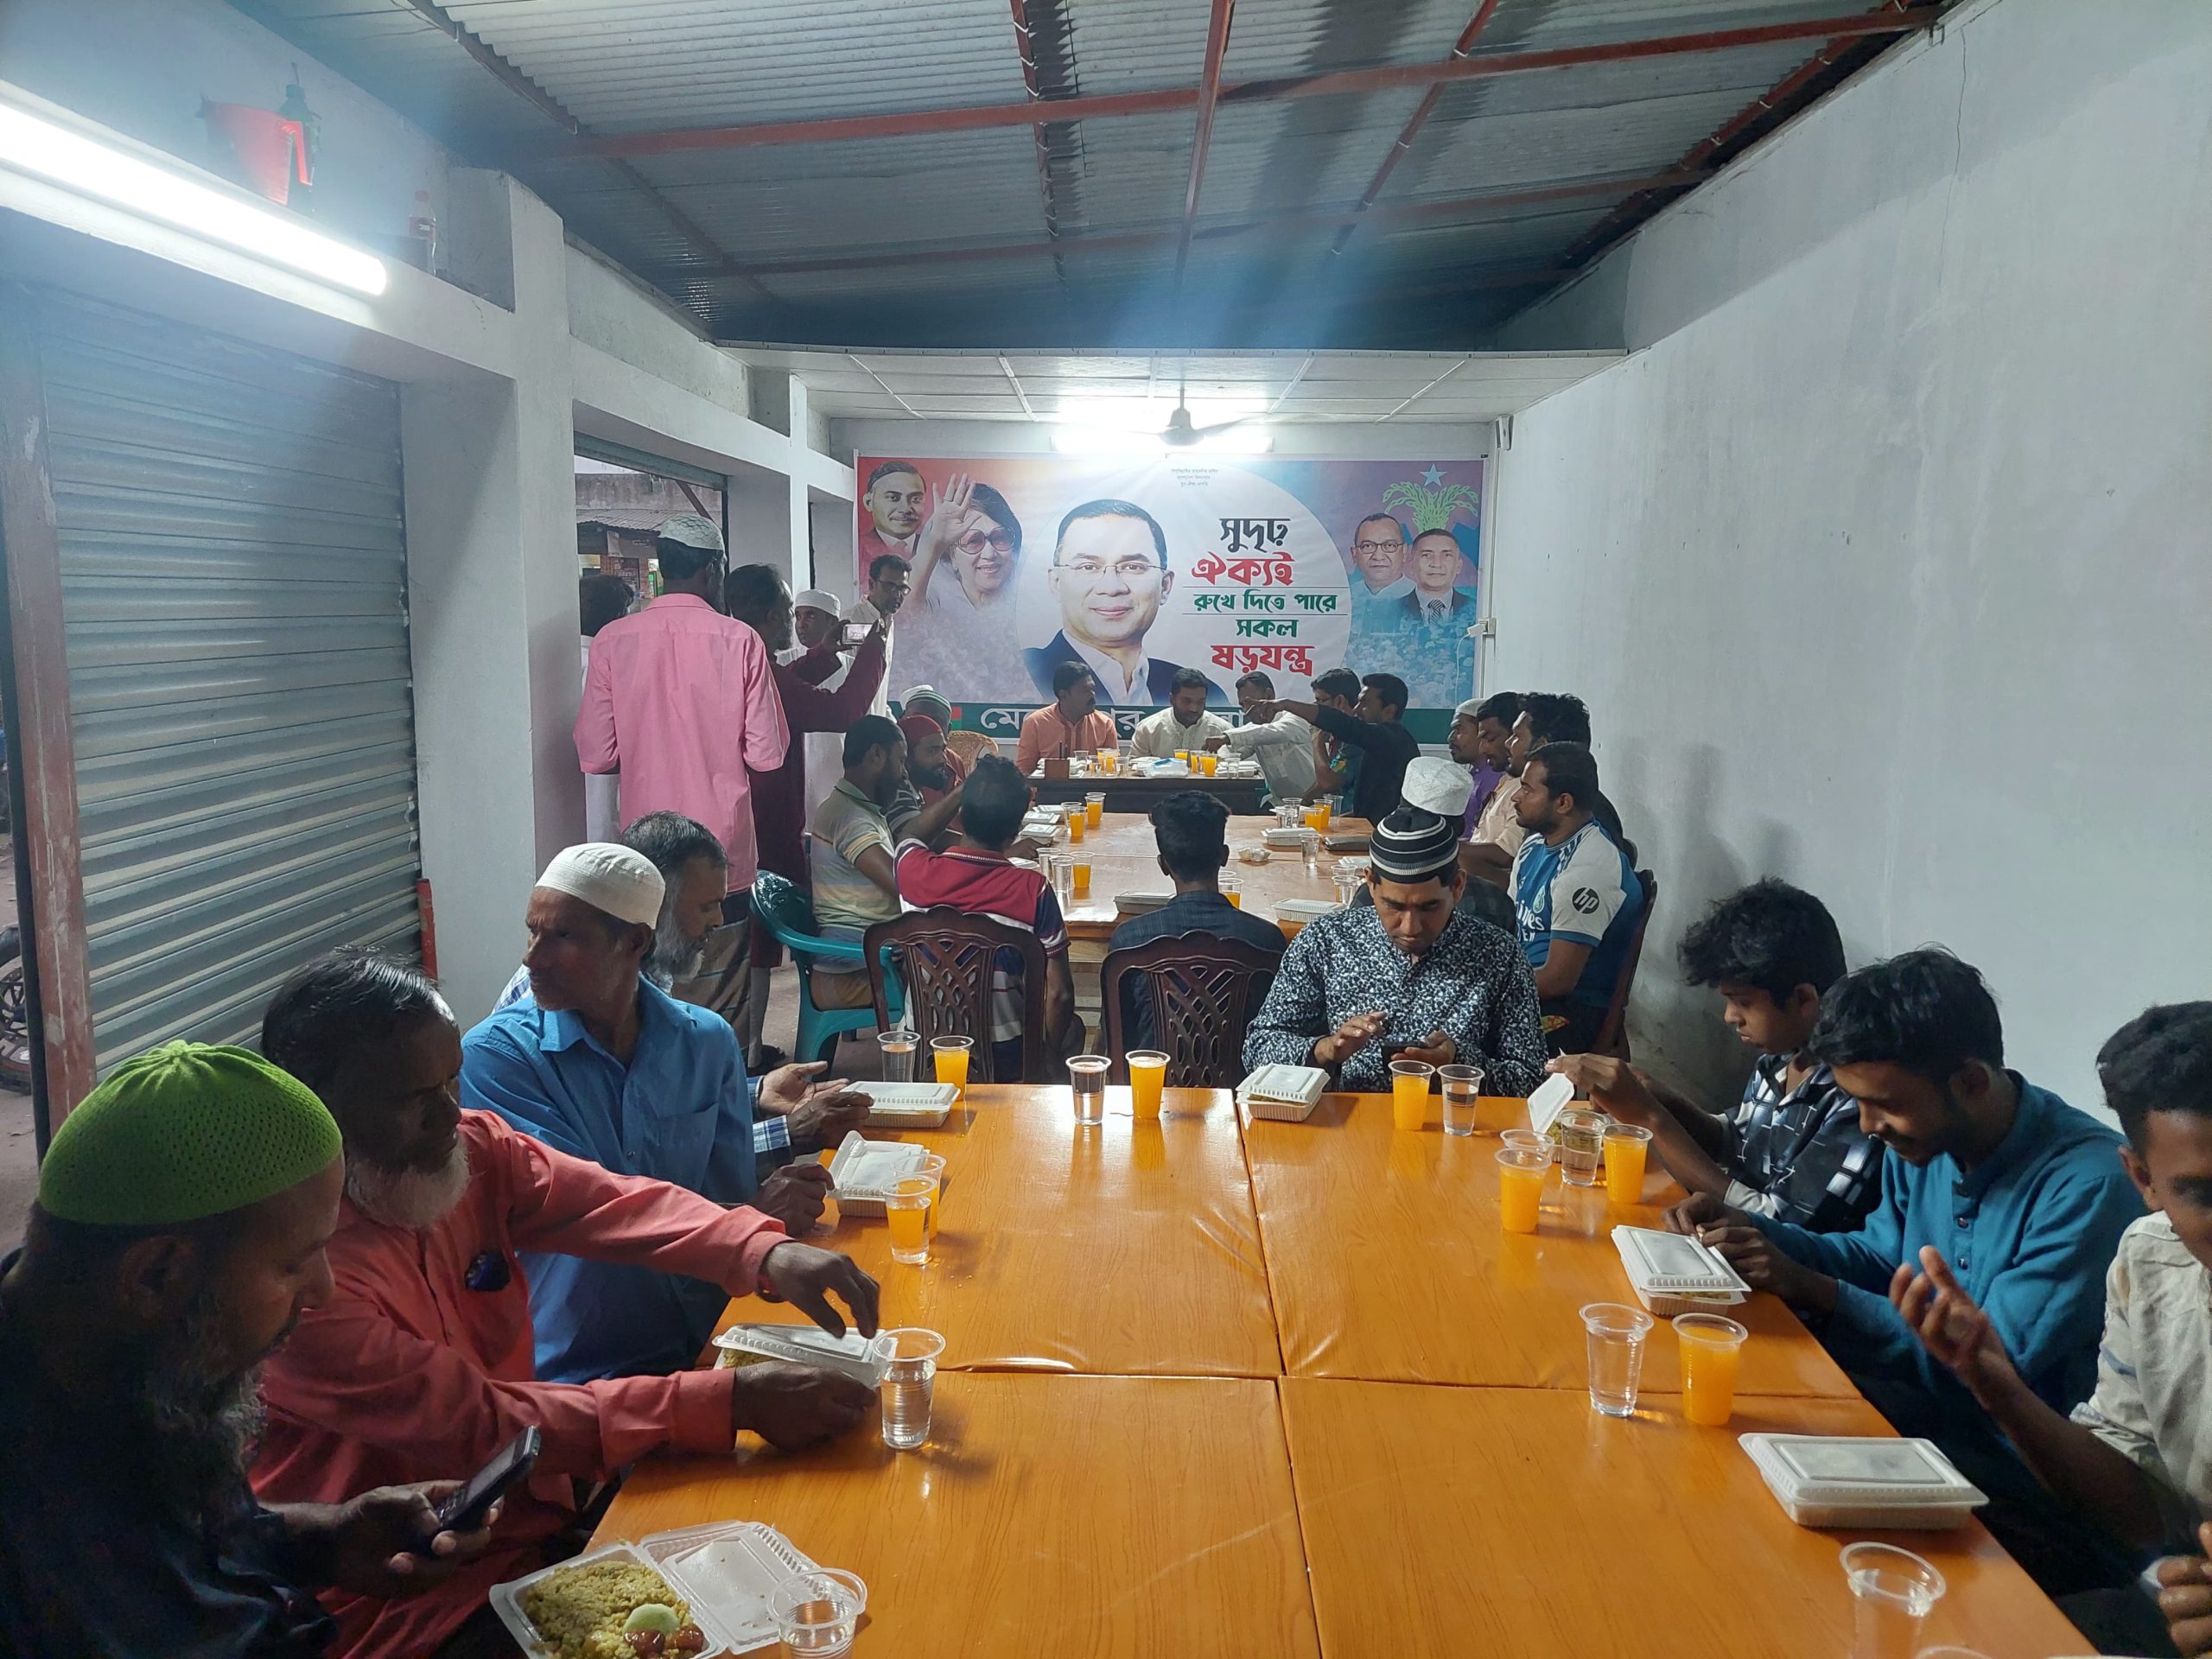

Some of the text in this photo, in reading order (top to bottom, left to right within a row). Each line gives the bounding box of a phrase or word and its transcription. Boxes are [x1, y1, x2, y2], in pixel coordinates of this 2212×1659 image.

[1219, 518, 1291, 553] সুদৃঢ়
[1191, 551, 1295, 586] ঐক্যই
[1193, 588, 1338, 613] রুখে দিতে পারে
[1236, 619, 1299, 638] সকল
[1211, 645, 1315, 677] ষড়যন্ত্র
[1573, 887, 1599, 913] hp
